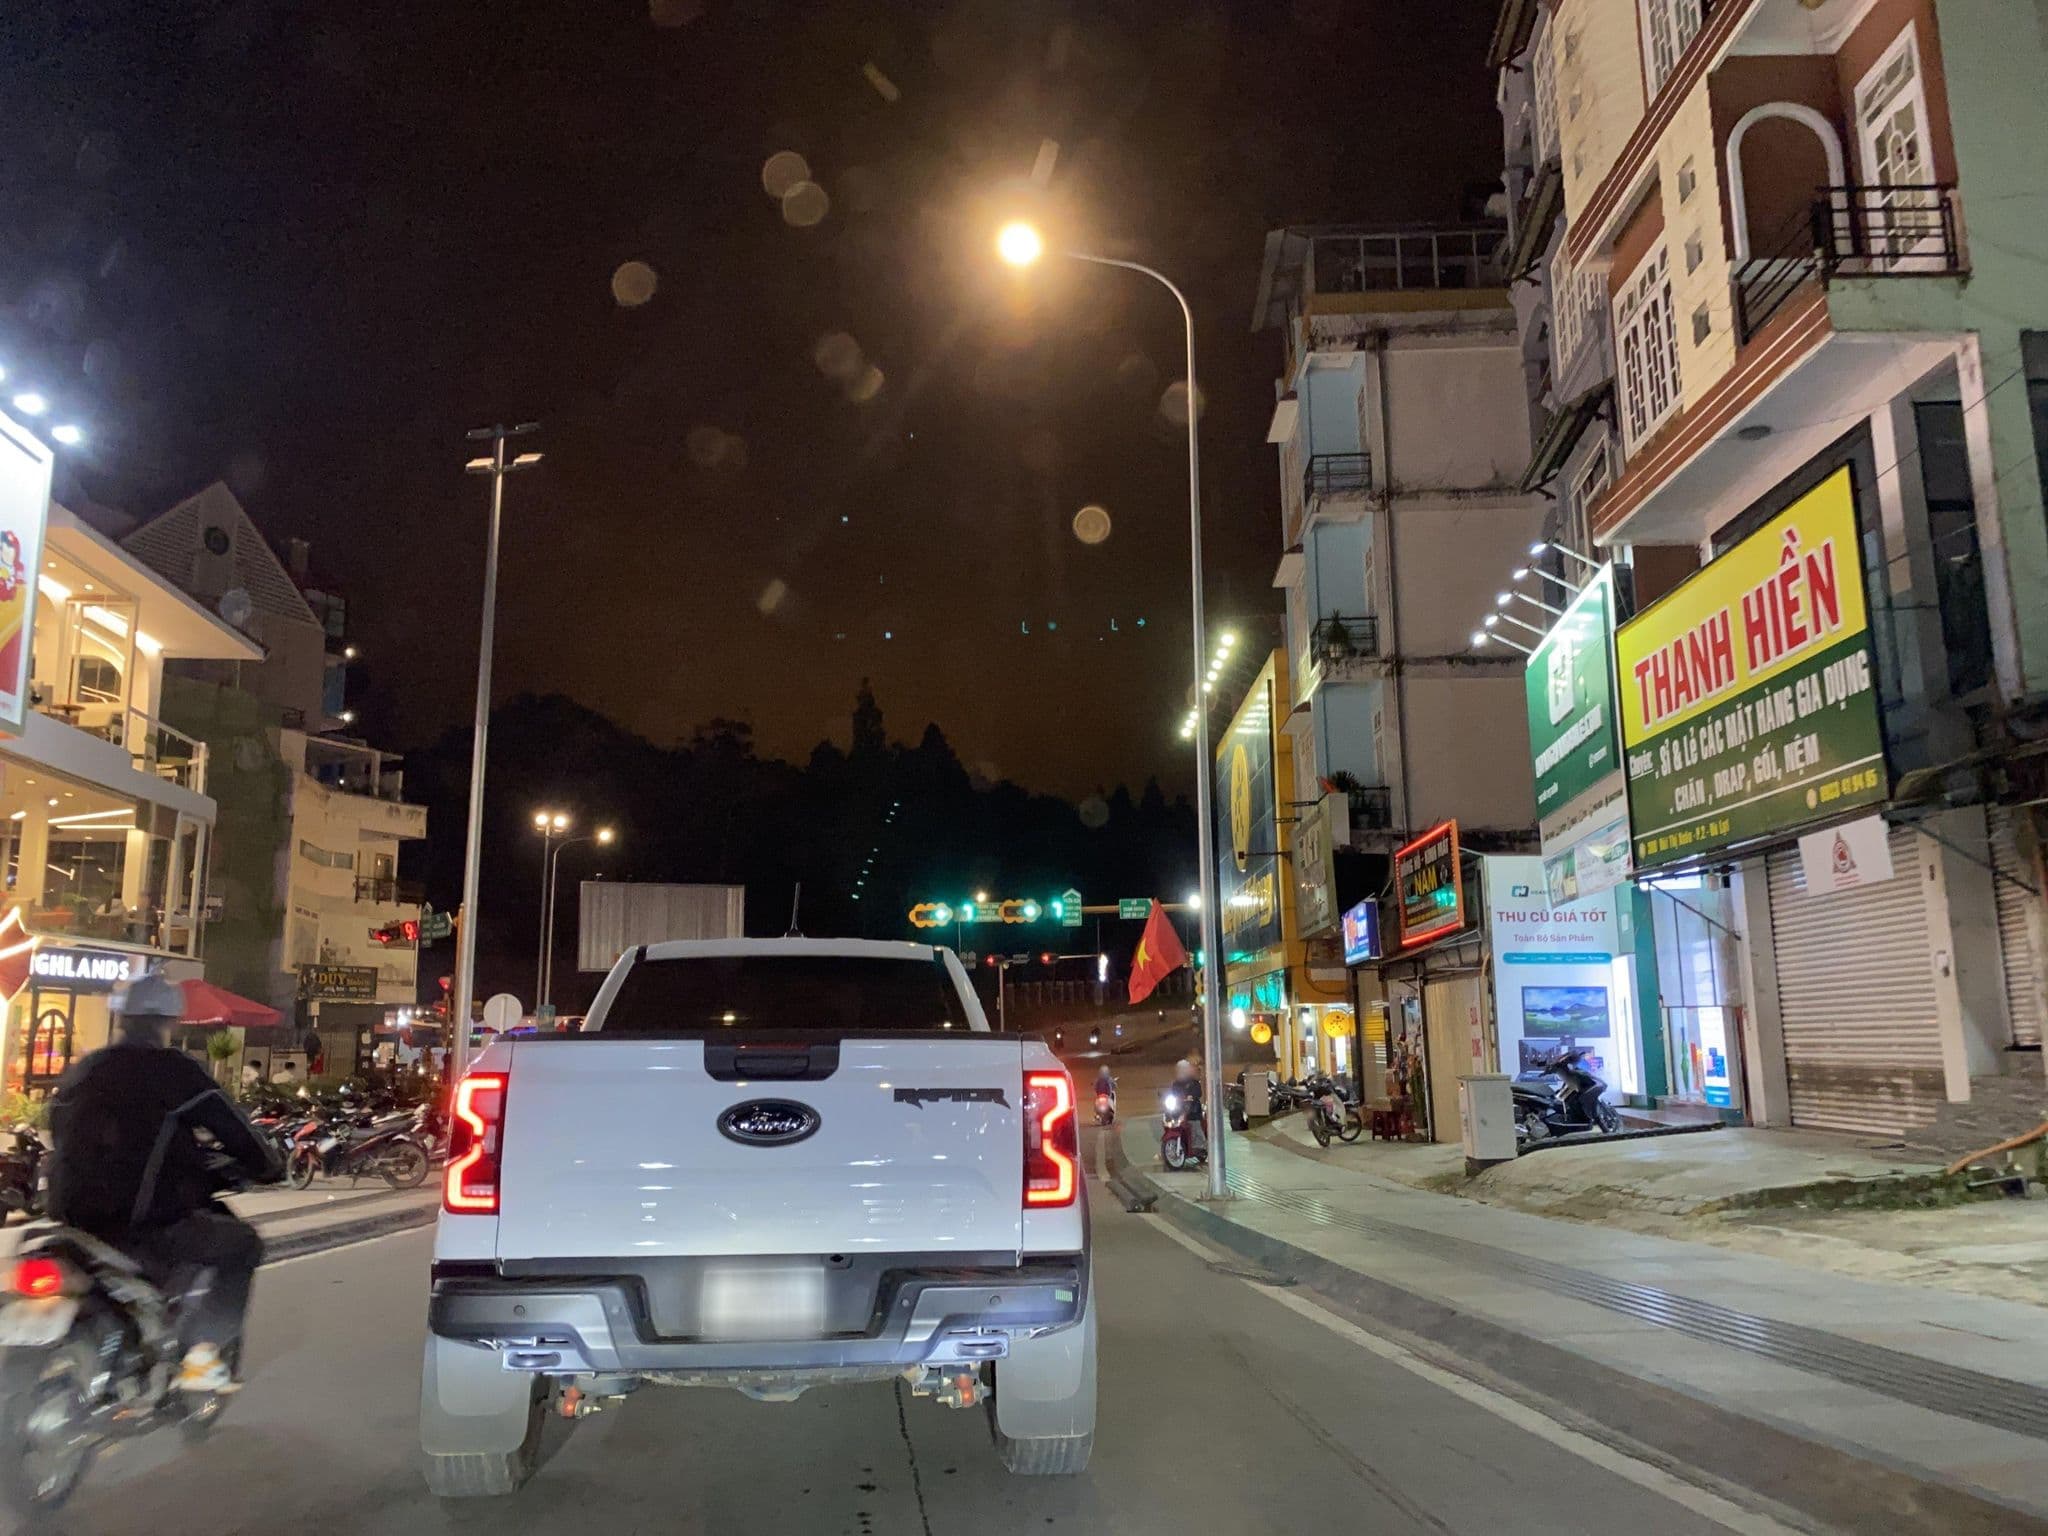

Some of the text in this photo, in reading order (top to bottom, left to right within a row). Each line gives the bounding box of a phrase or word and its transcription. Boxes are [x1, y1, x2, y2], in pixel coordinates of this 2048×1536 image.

[1634, 527, 1841, 727] THANH HIỀN
[1672, 739, 1683, 771] &
[1699, 716, 1724, 760] CÁC
[1755, 688, 1796, 736] HÀNG
[1796, 673, 1823, 718] GIA
[1823, 649, 1871, 711] DỤNG
[1414, 864, 1438, 898] NAM
[1496, 906, 1608, 923] THU CŨ GIÁ TỐT
[319, 973, 347, 985] DUY
[893, 1087, 1011, 1110] RAPTOR
